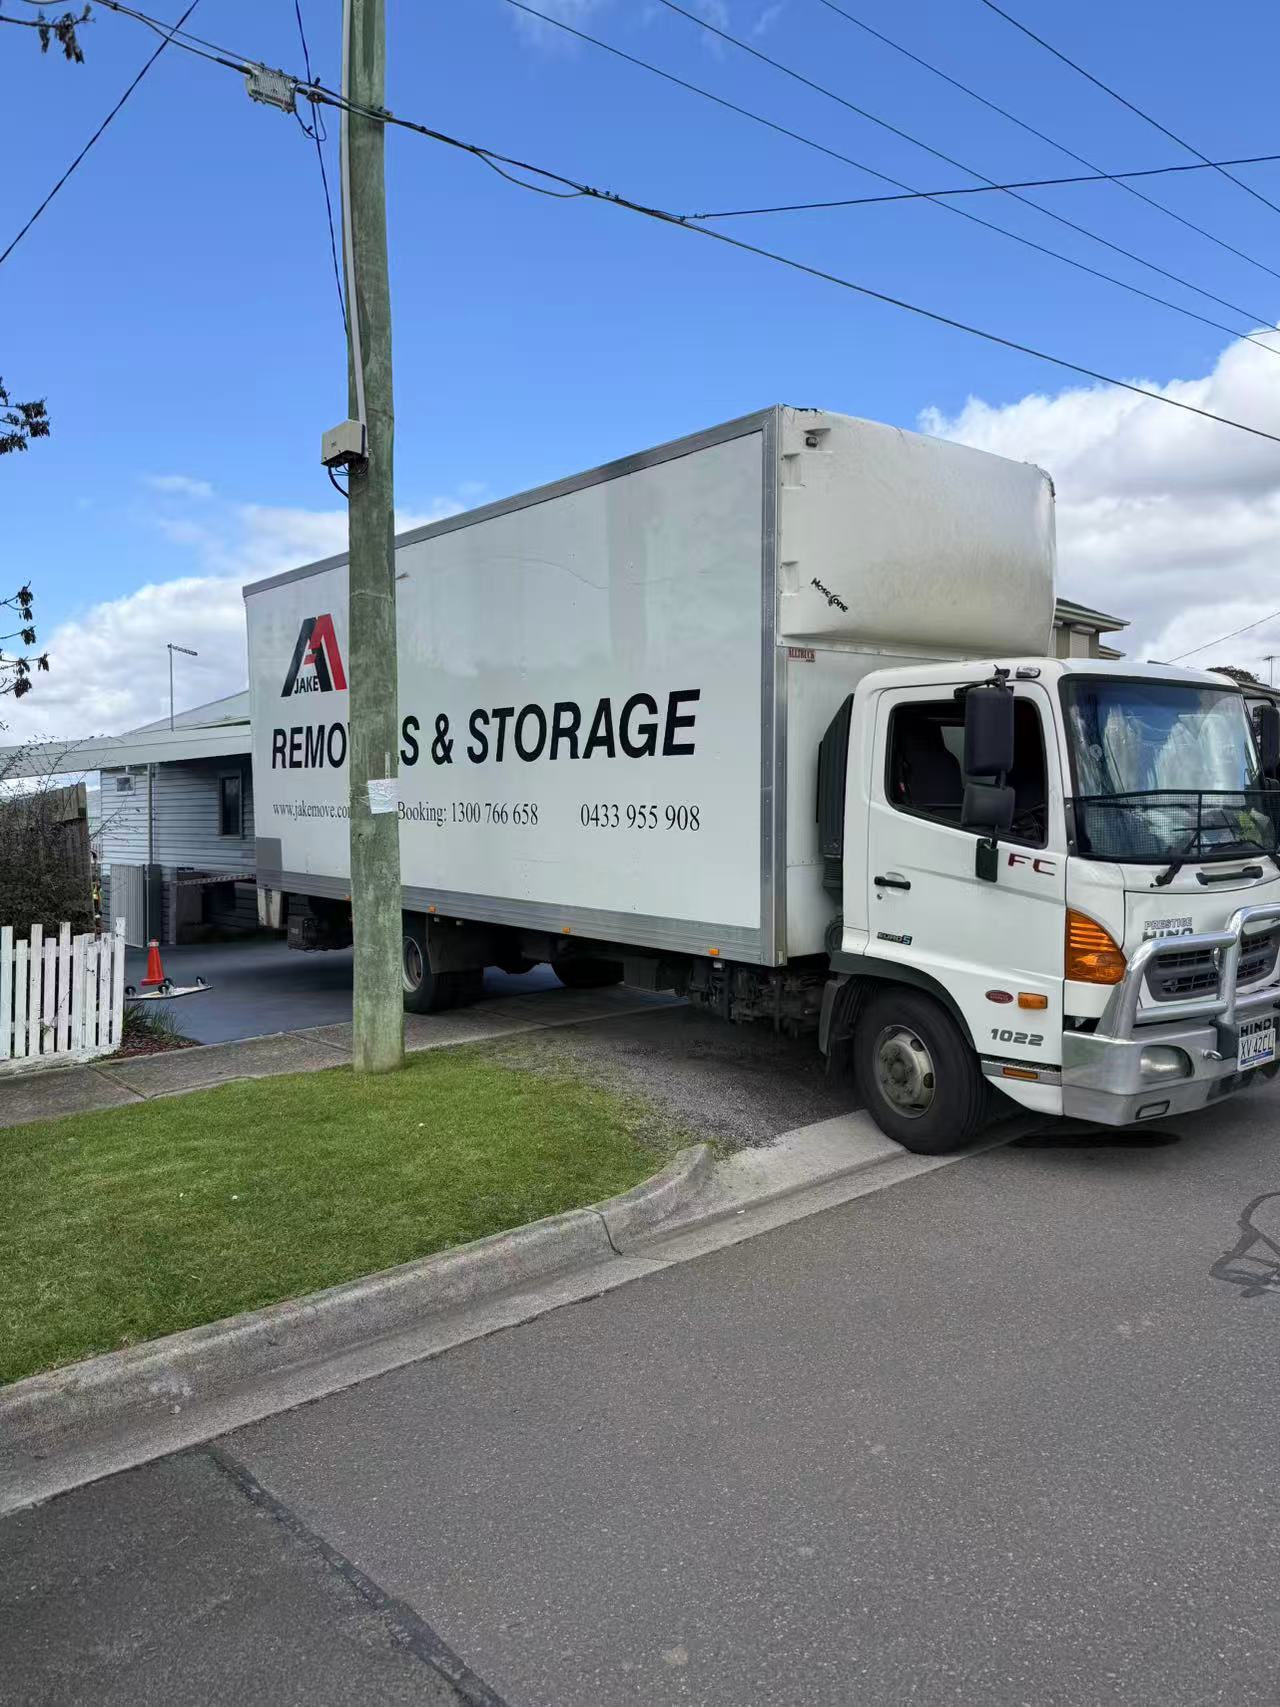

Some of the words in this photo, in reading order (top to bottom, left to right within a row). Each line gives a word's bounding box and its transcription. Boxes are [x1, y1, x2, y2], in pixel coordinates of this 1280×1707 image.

[294, 676, 321, 694] JAKE
[272, 715, 420, 769] REMOS
[431, 713, 454, 765] &
[467, 689, 700, 764] STORAGE
[397, 801, 447, 827] Booking:
[451, 802, 481, 823] 1300
[485, 803, 509, 824] 766
[513, 803, 539, 826] 658
[580, 803, 620, 829] 0433
[626, 804, 658, 830] 955
[665, 805, 700, 832] 908
[1008, 852, 1056, 876] FC
[991, 1028, 1044, 1047] 1022
